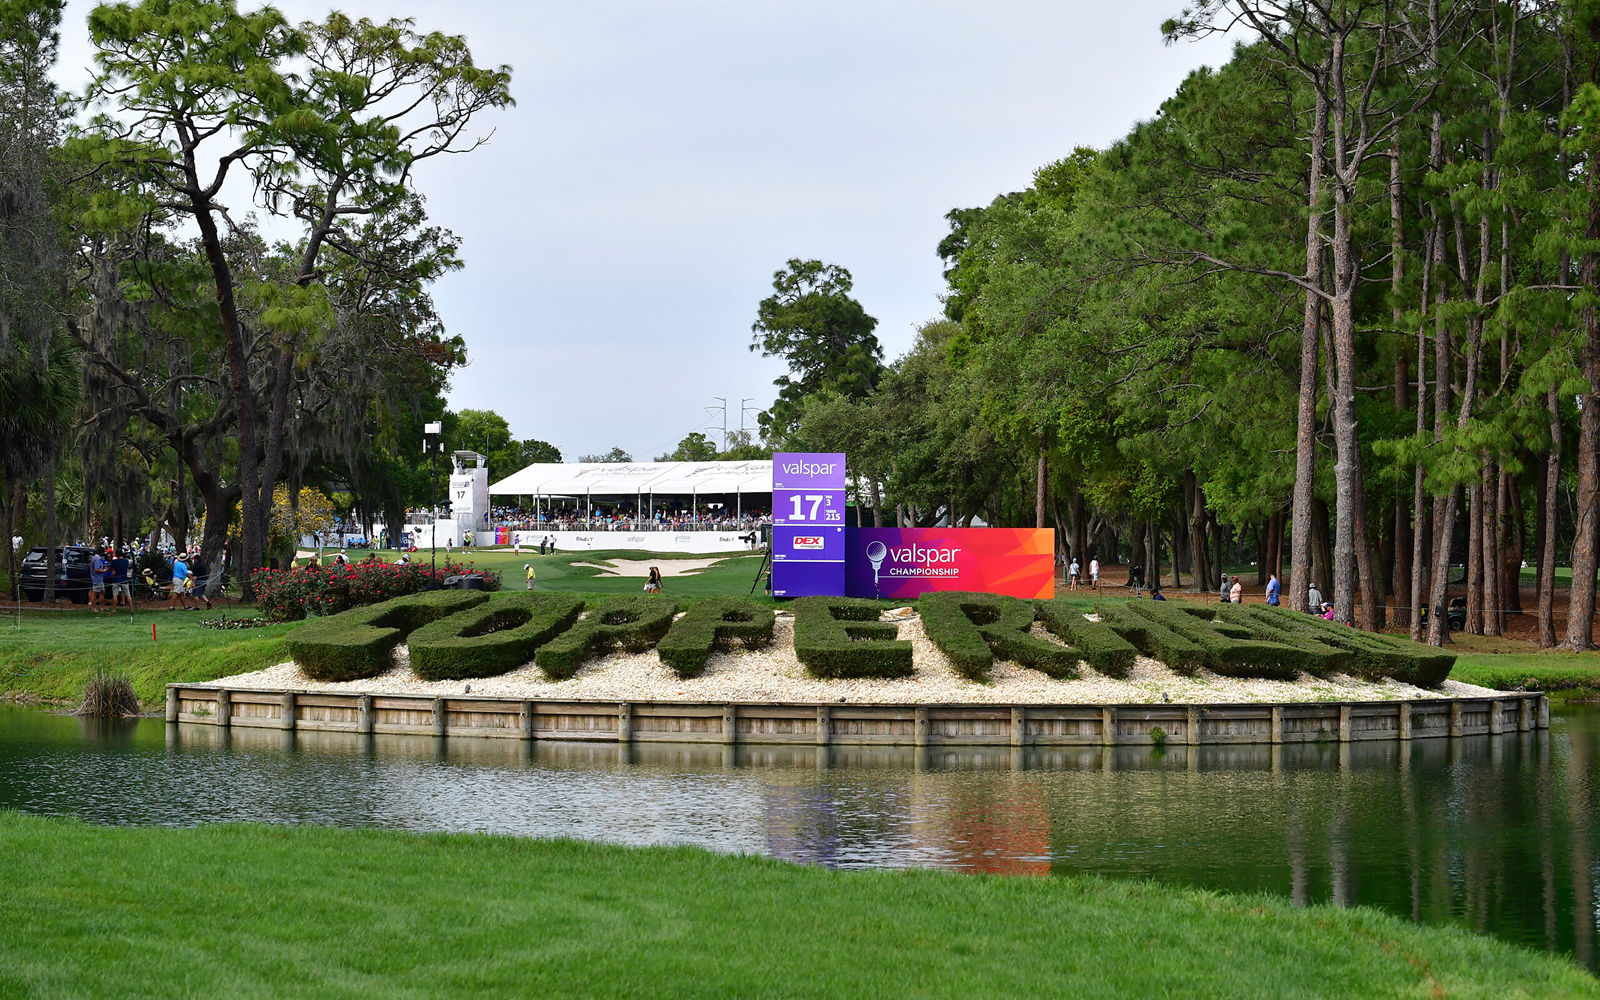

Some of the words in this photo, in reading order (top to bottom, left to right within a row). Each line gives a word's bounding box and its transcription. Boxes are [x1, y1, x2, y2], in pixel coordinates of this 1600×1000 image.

[782, 459, 838, 478] valspar
[457, 491, 465, 499] 17
[788, 494, 824, 520] 17
[825, 499, 832, 507] 3
[825, 513, 841, 521] 215
[626, 535, 646, 543] valspar
[889, 543, 961, 567] valspar
[889, 567, 960, 576] CHAMPIONSHIP
